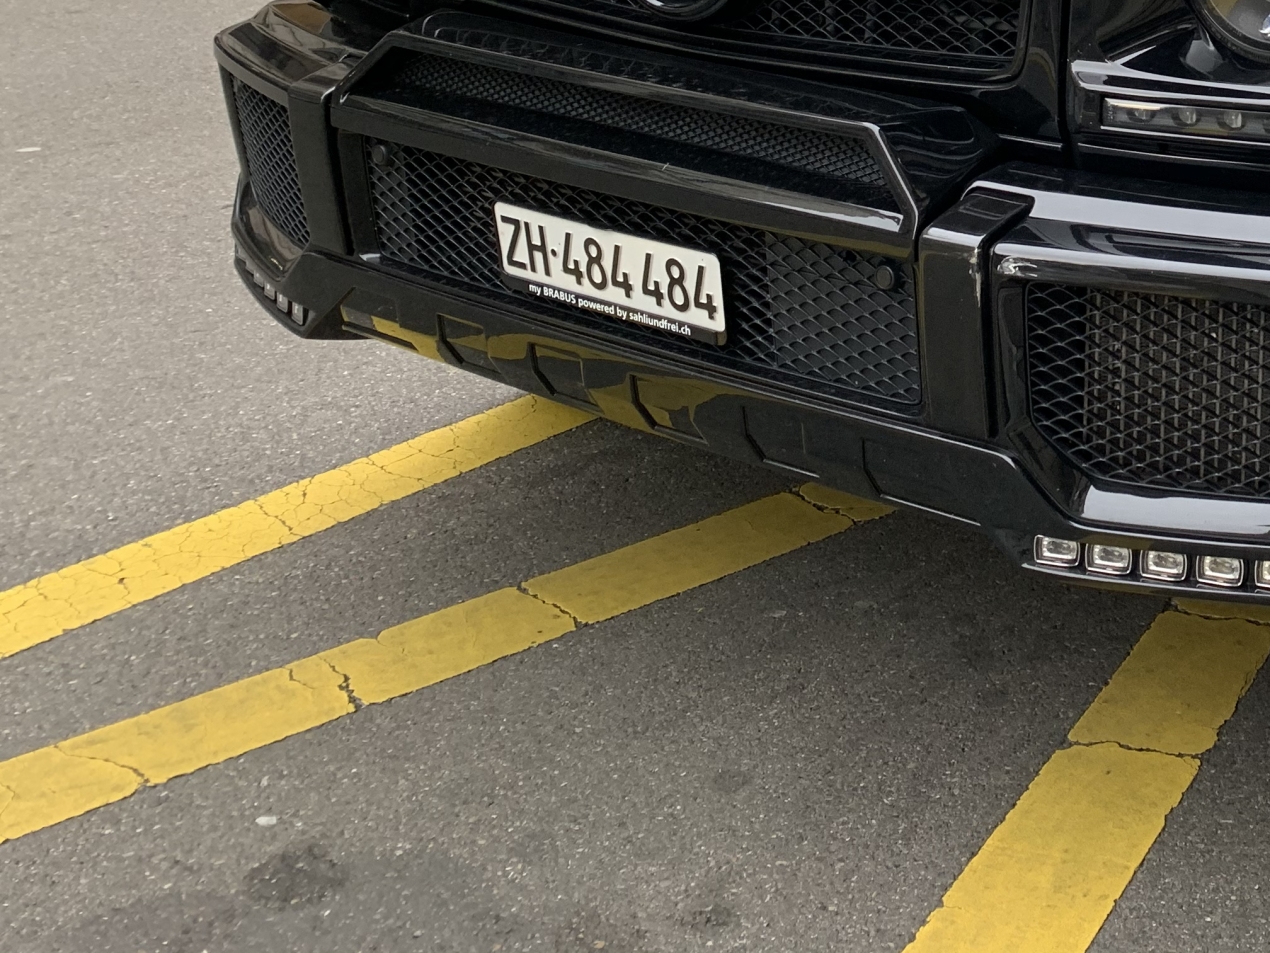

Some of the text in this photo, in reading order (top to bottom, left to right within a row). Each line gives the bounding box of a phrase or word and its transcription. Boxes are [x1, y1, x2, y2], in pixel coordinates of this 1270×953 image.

[528, 284, 691, 336] my BRABUS powered by sahliundfrei.ch
